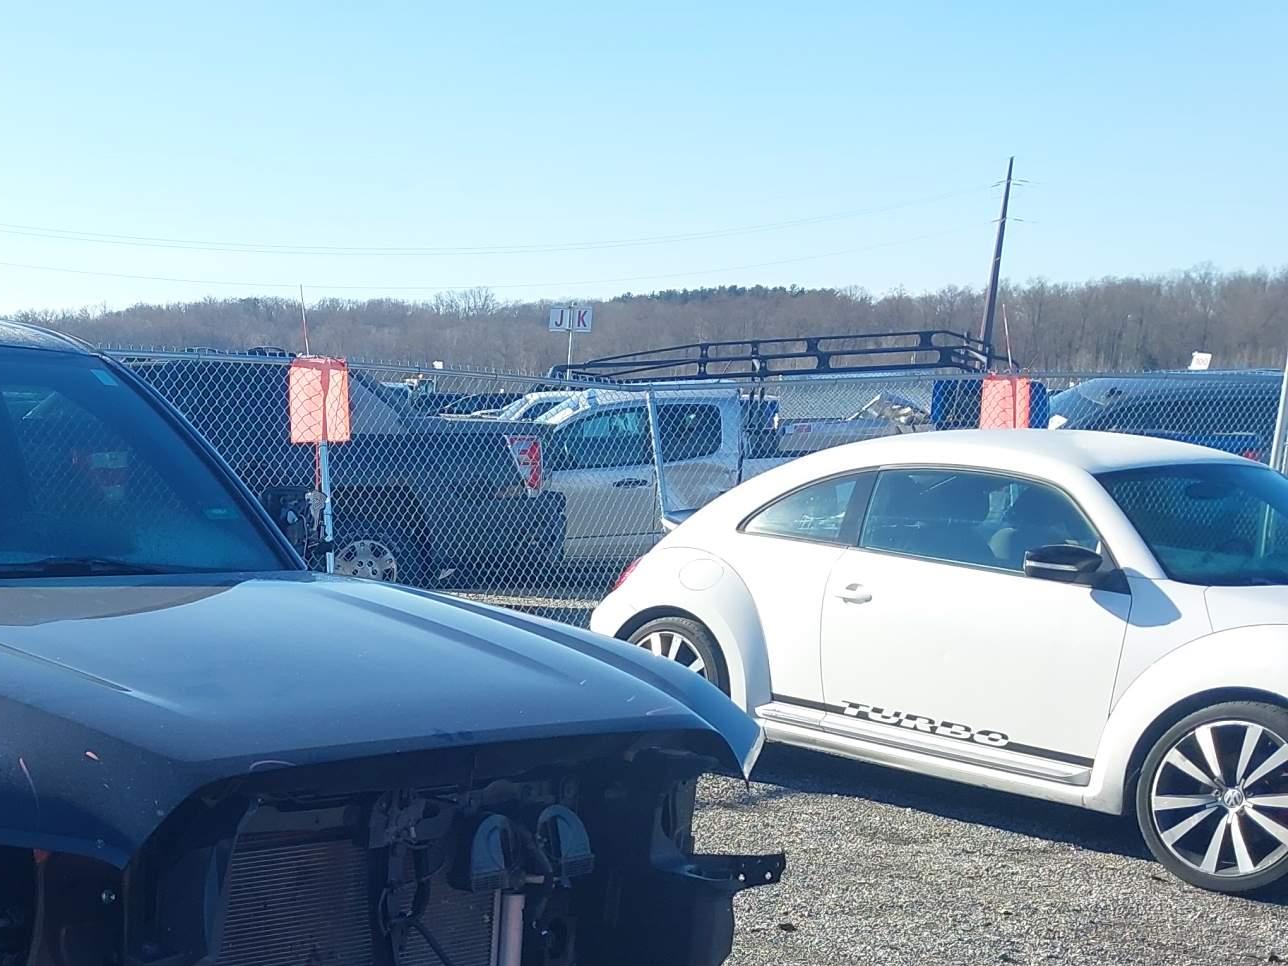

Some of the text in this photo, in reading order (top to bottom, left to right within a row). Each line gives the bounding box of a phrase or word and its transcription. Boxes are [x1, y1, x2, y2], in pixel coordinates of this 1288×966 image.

[554, 309, 588, 328] J K
[842, 700, 1009, 747] TURBO
